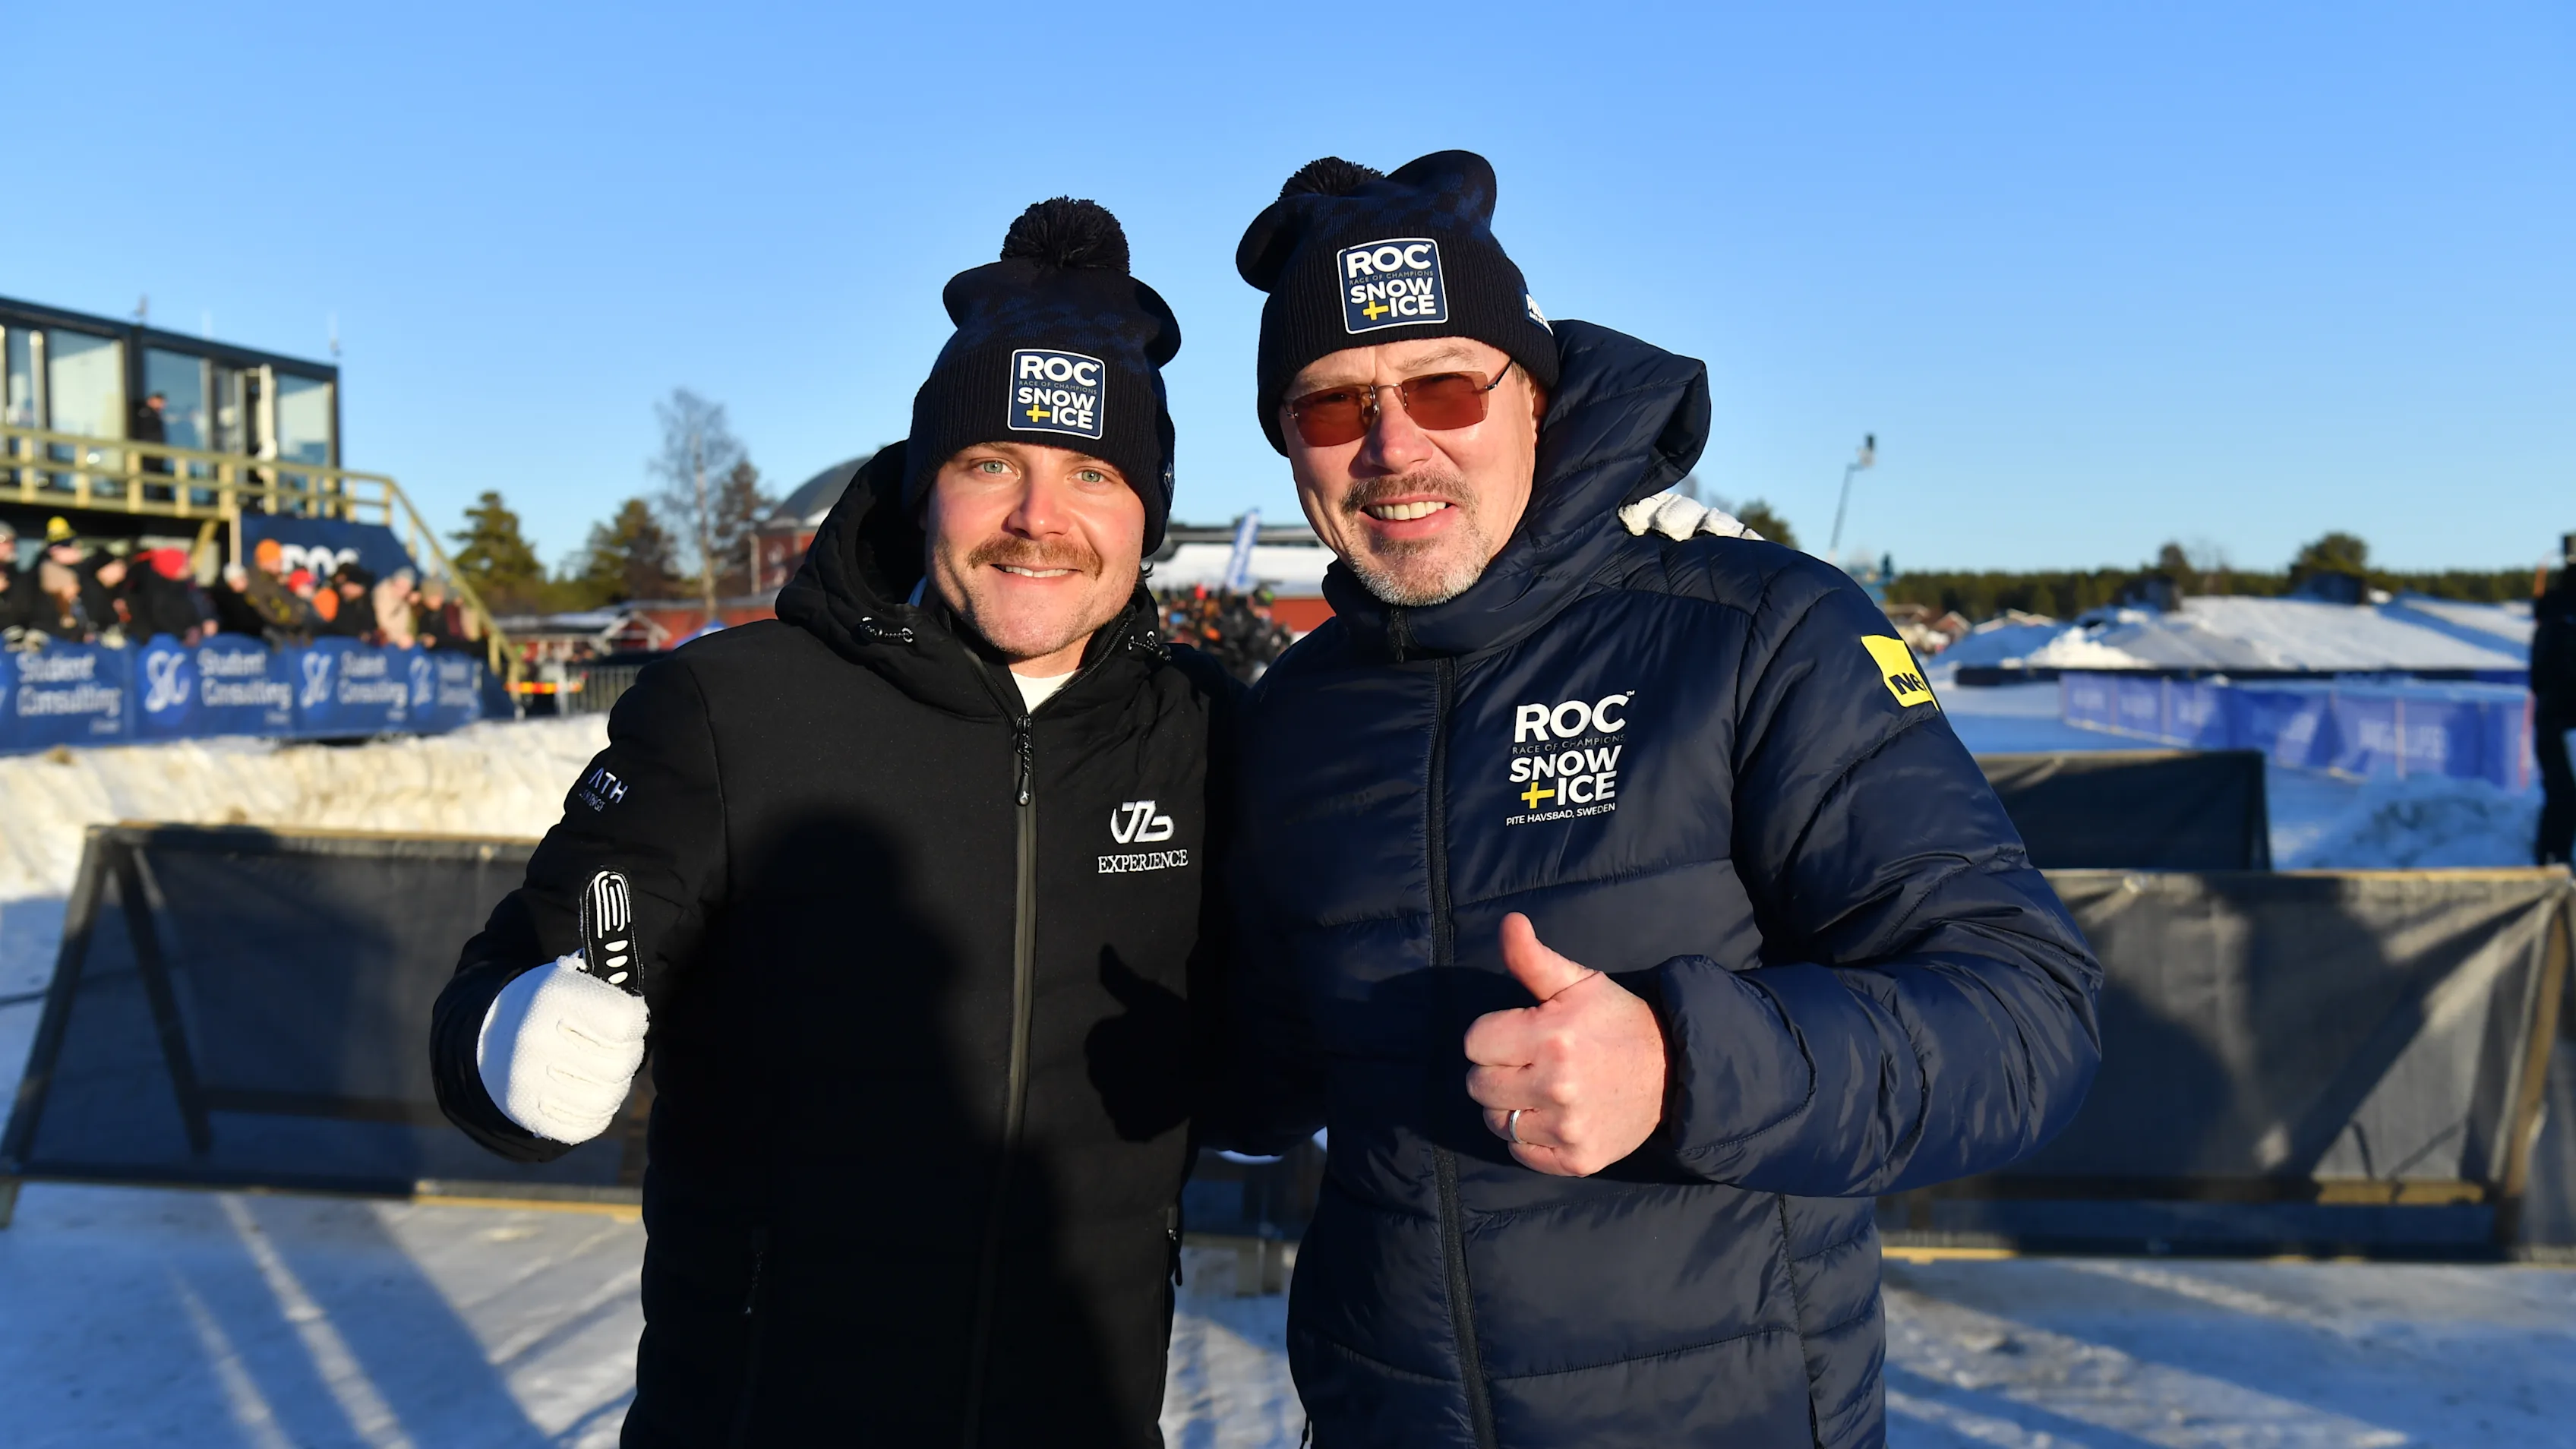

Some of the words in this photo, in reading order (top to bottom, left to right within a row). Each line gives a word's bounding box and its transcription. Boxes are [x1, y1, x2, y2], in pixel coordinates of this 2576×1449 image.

[1346, 244, 1432, 279] ROC
[1349, 277, 1369, 286] RACE
[1386, 270, 1434, 279] CHAMPIONS
[1350, 277, 1434, 304] SNOW
[1019, 355, 1099, 387] ROC
[1017, 387, 1096, 411] SNOW
[1053, 383, 1097, 395] CHAMPIONS
[1514, 694, 1630, 743] ROC
[1512, 744, 1541, 755] RACE
[1544, 742, 1558, 752] OF
[1561, 734, 1626, 750] CHAMPIONS
[1508, 744, 1623, 783] SNOW
[1506, 815, 1526, 826] PITE
[1576, 802, 1616, 818] SWEDEN
[1097, 849, 1189, 874] EXPERIENCE
